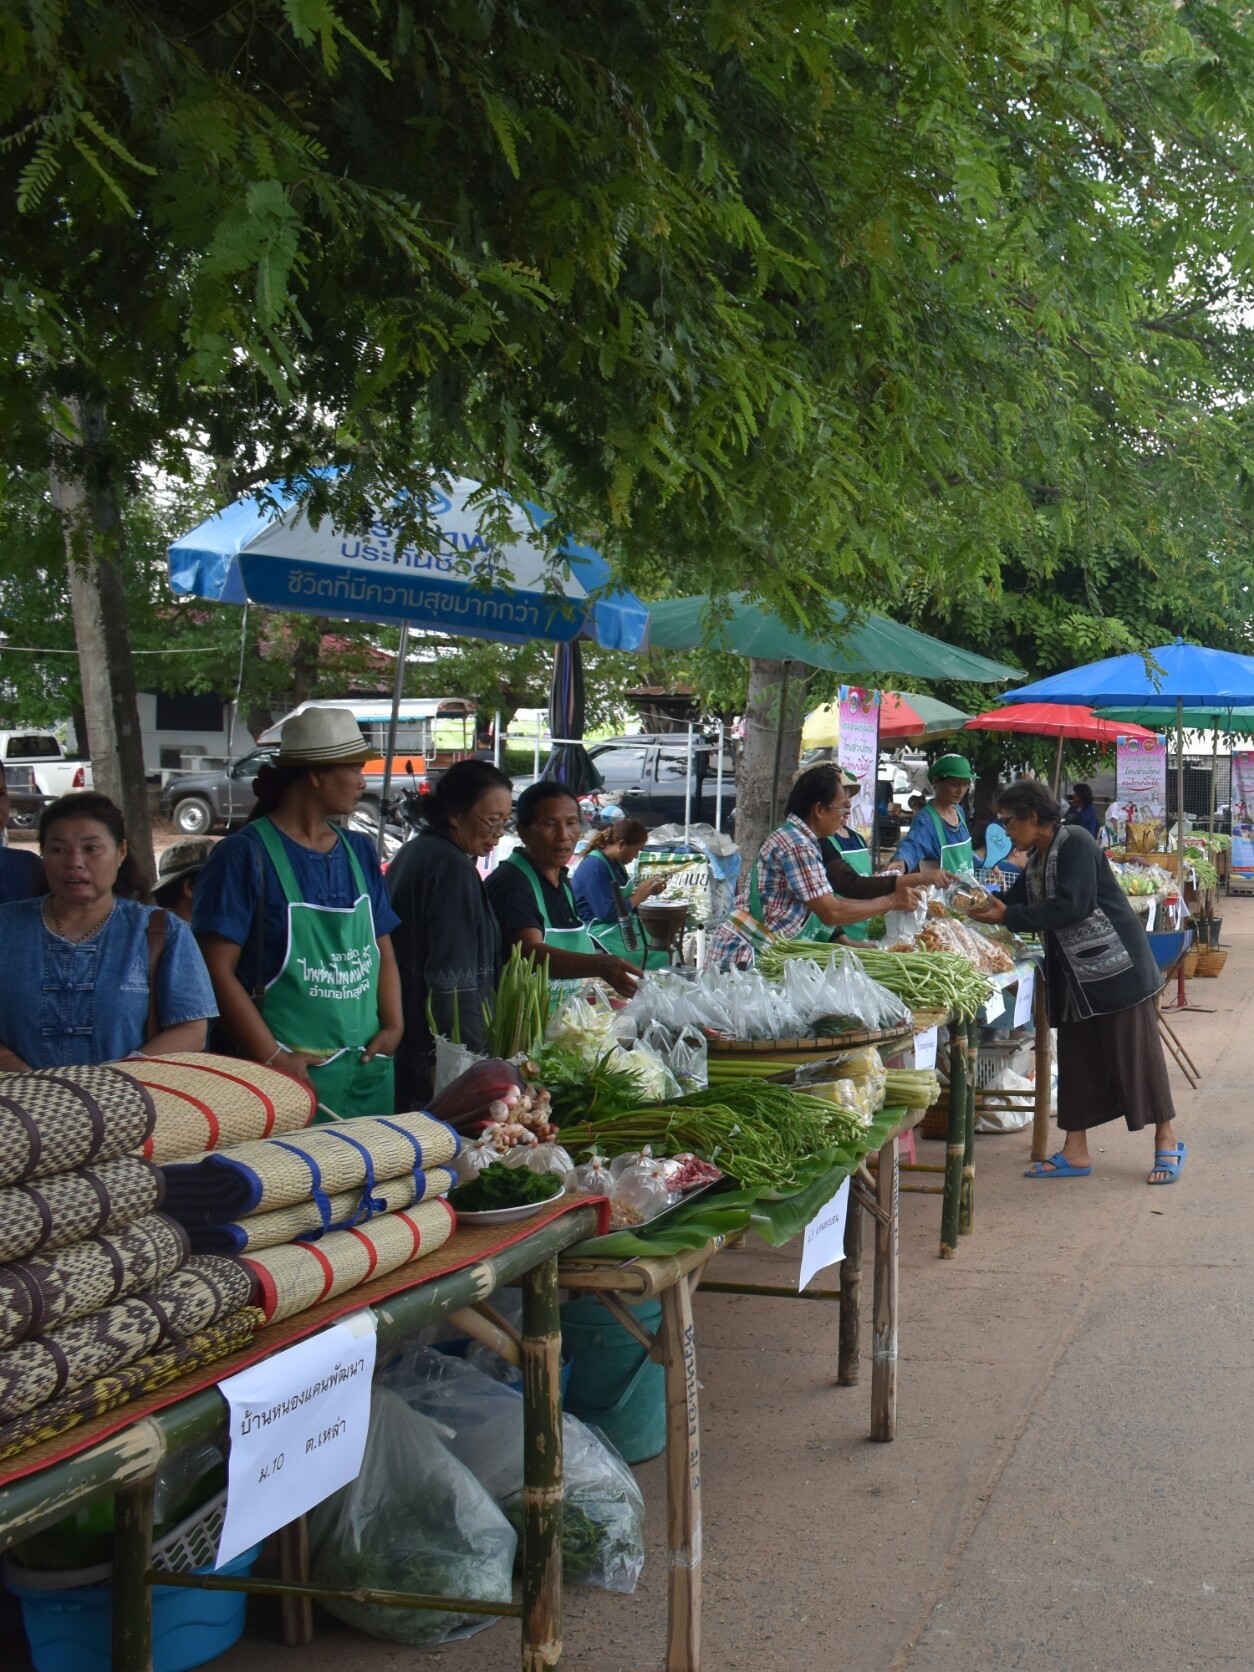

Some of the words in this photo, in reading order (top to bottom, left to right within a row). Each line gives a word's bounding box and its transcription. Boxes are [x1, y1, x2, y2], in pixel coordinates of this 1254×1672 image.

[288, 570, 539, 625] ชีวิตที่มีความสุขมากกว่า
[240, 1358, 365, 1436] บ้านหนองแคนพัฒนา
[258, 1452, 285, 1483] ม.10
[305, 1415, 346, 1454] ต.เหล่า
